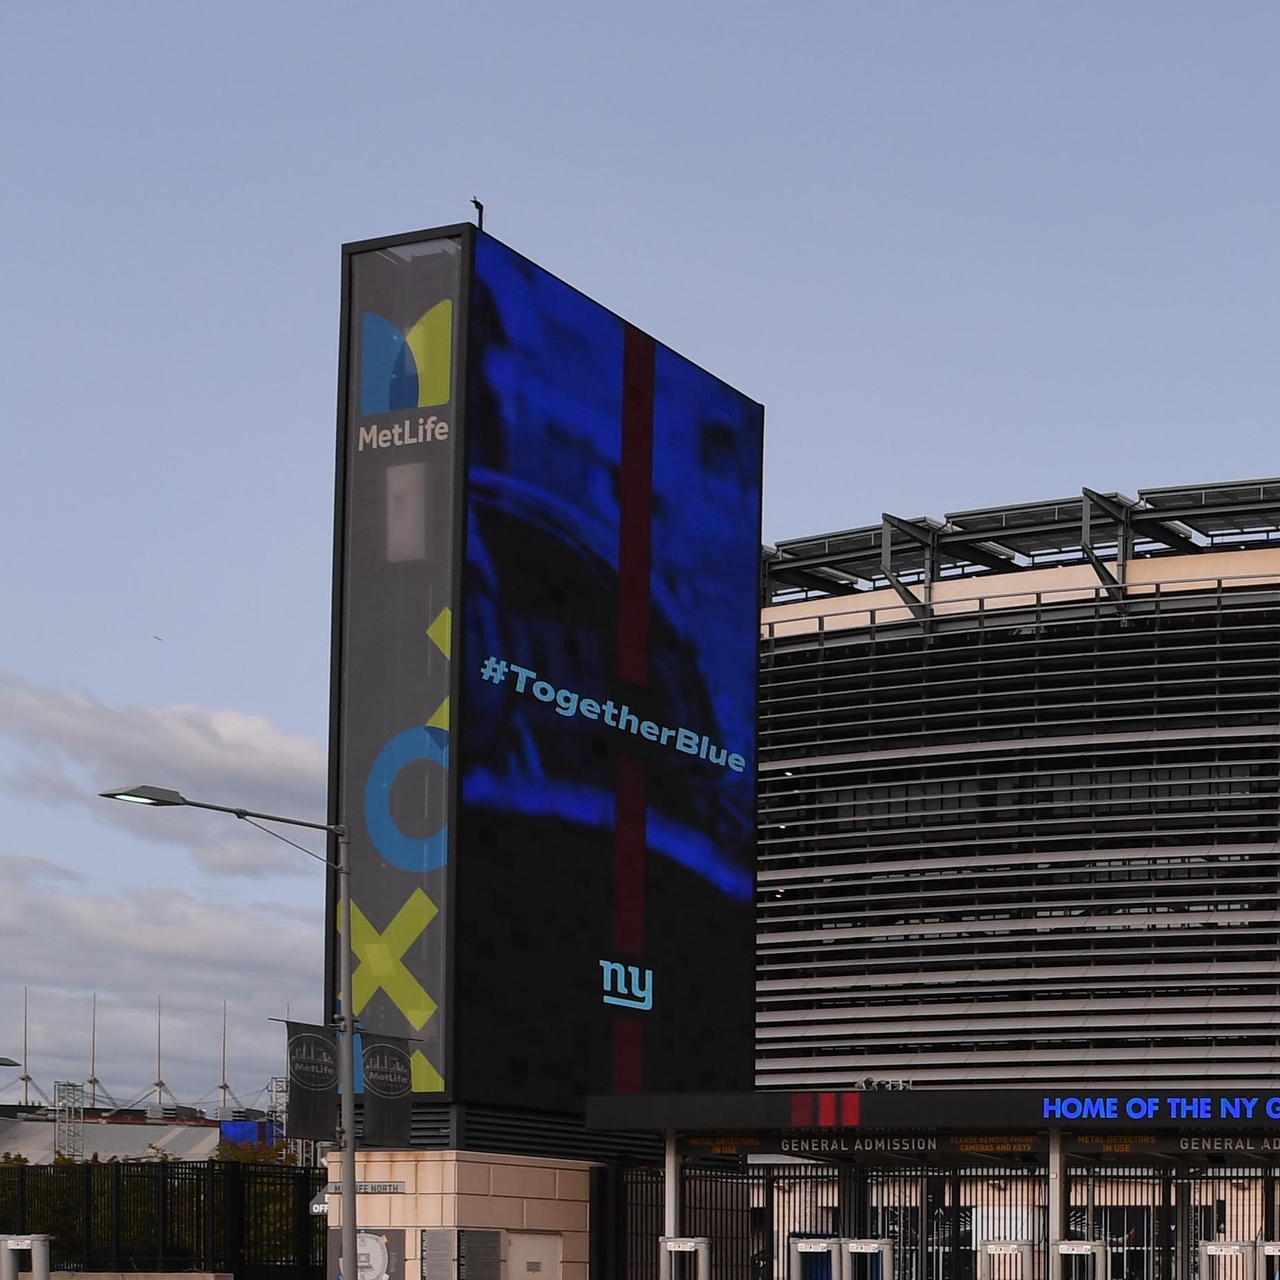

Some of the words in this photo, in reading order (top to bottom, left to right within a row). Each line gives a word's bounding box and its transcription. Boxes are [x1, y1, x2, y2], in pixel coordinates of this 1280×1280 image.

[357, 416, 449, 451] MetLife
[480, 656, 746, 773] #TogetherBlue
[1043, 1097, 1118, 1119] HOME
[1126, 1097, 1160, 1119] OF
[1167, 1097, 1212, 1119] THE
[1220, 1097, 1259, 1119] NY
[781, 1139, 849, 1151] GENERAL
[854, 1138, 938, 1150] ADMISSION
[960, 1143, 994, 1151] CAMERAS
[1103, 1144, 1112, 1152] IN
[1114, 1144, 1130, 1152] USE
[1179, 1138, 1255, 1150] GENERAL
[371, 1184, 399, 1193] NORTH
